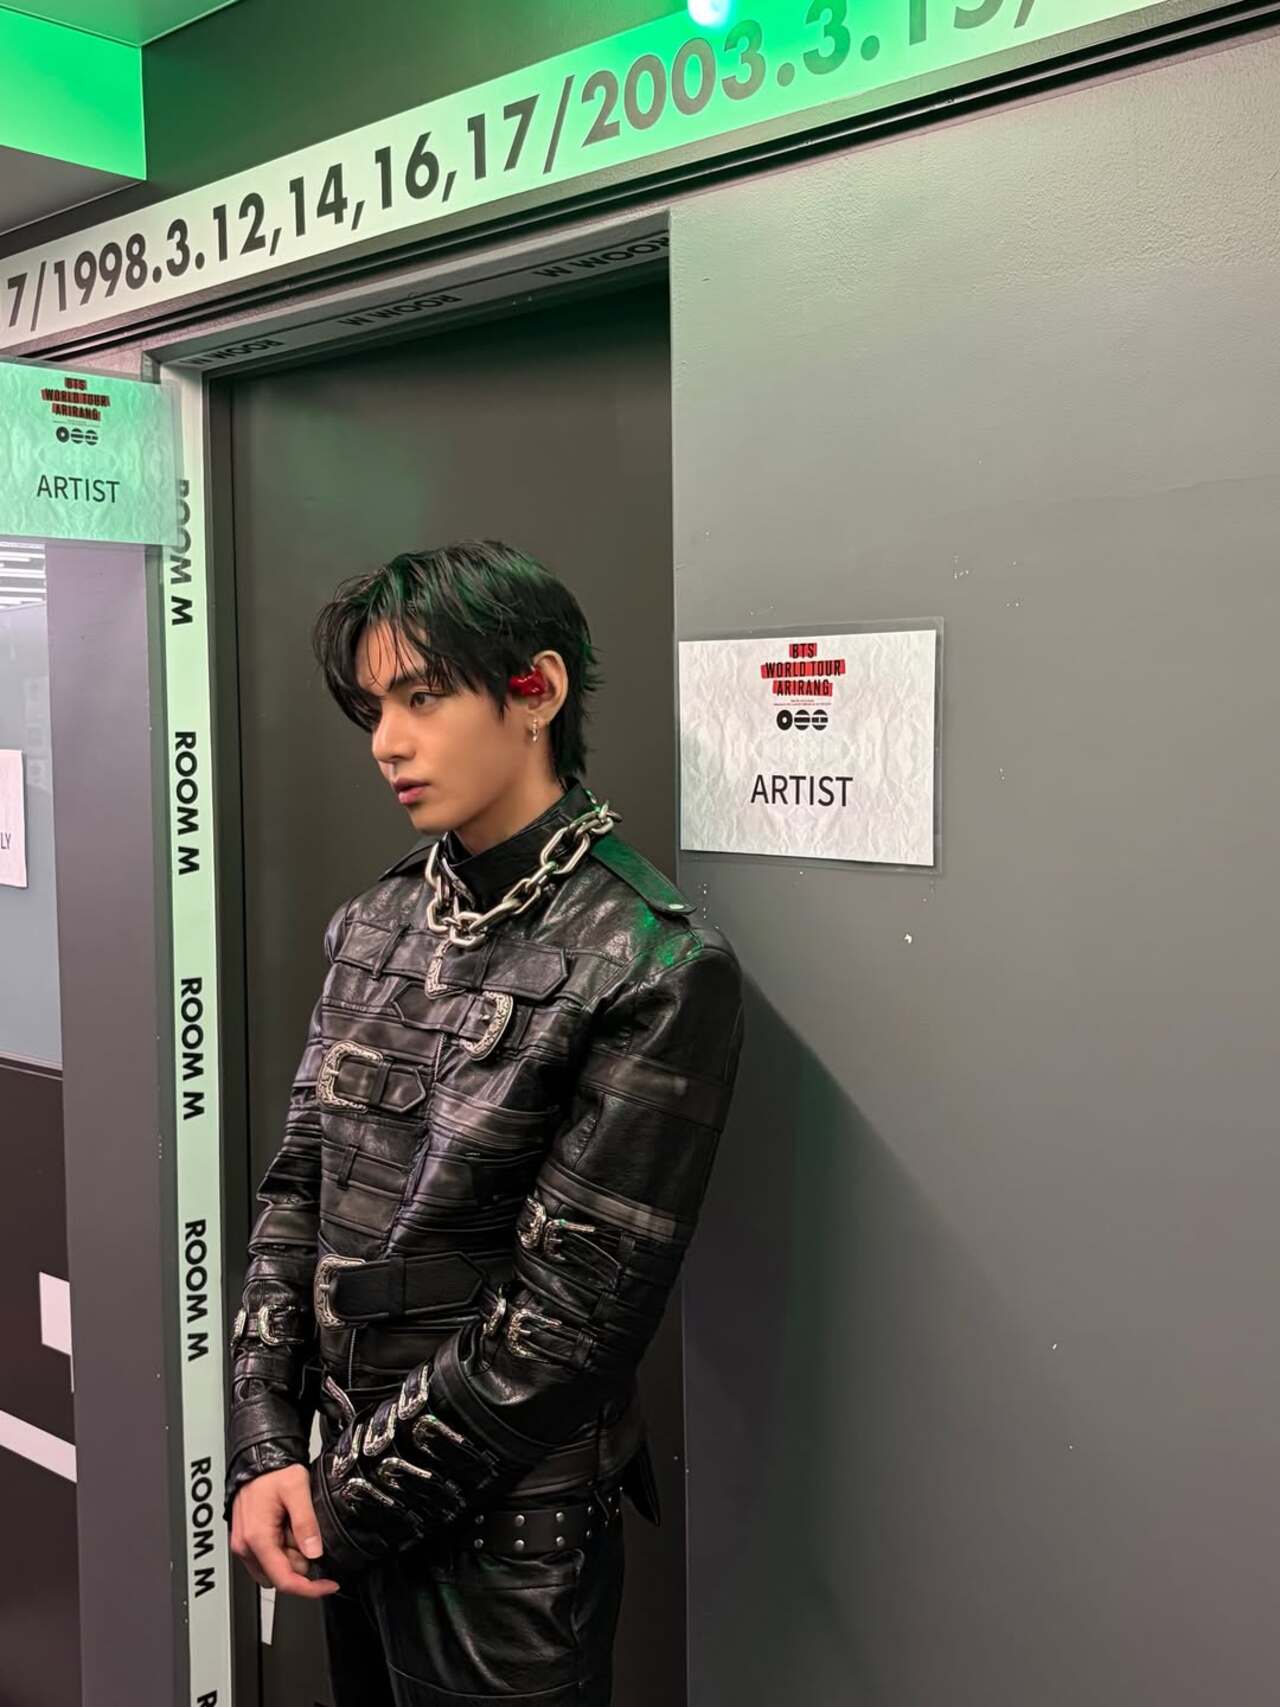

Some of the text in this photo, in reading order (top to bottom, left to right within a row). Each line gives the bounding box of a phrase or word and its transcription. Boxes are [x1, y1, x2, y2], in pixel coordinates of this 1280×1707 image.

[365, 294, 463, 318] ROOM
[37, 475, 120, 503] ARTIST
[171, 595, 193, 626] M
[792, 643, 815, 659] BTS
[765, 659, 841, 678] WORLD TOUR
[777, 679, 829, 697] ARIRANG
[175, 731, 200, 875] ROOM M
[750, 774, 854, 807] ARTIST
[181, 977, 205, 1120] ROOM M
[185, 1219, 209, 1361] ROOM M
[191, 1457, 216, 1598] ROOM M
